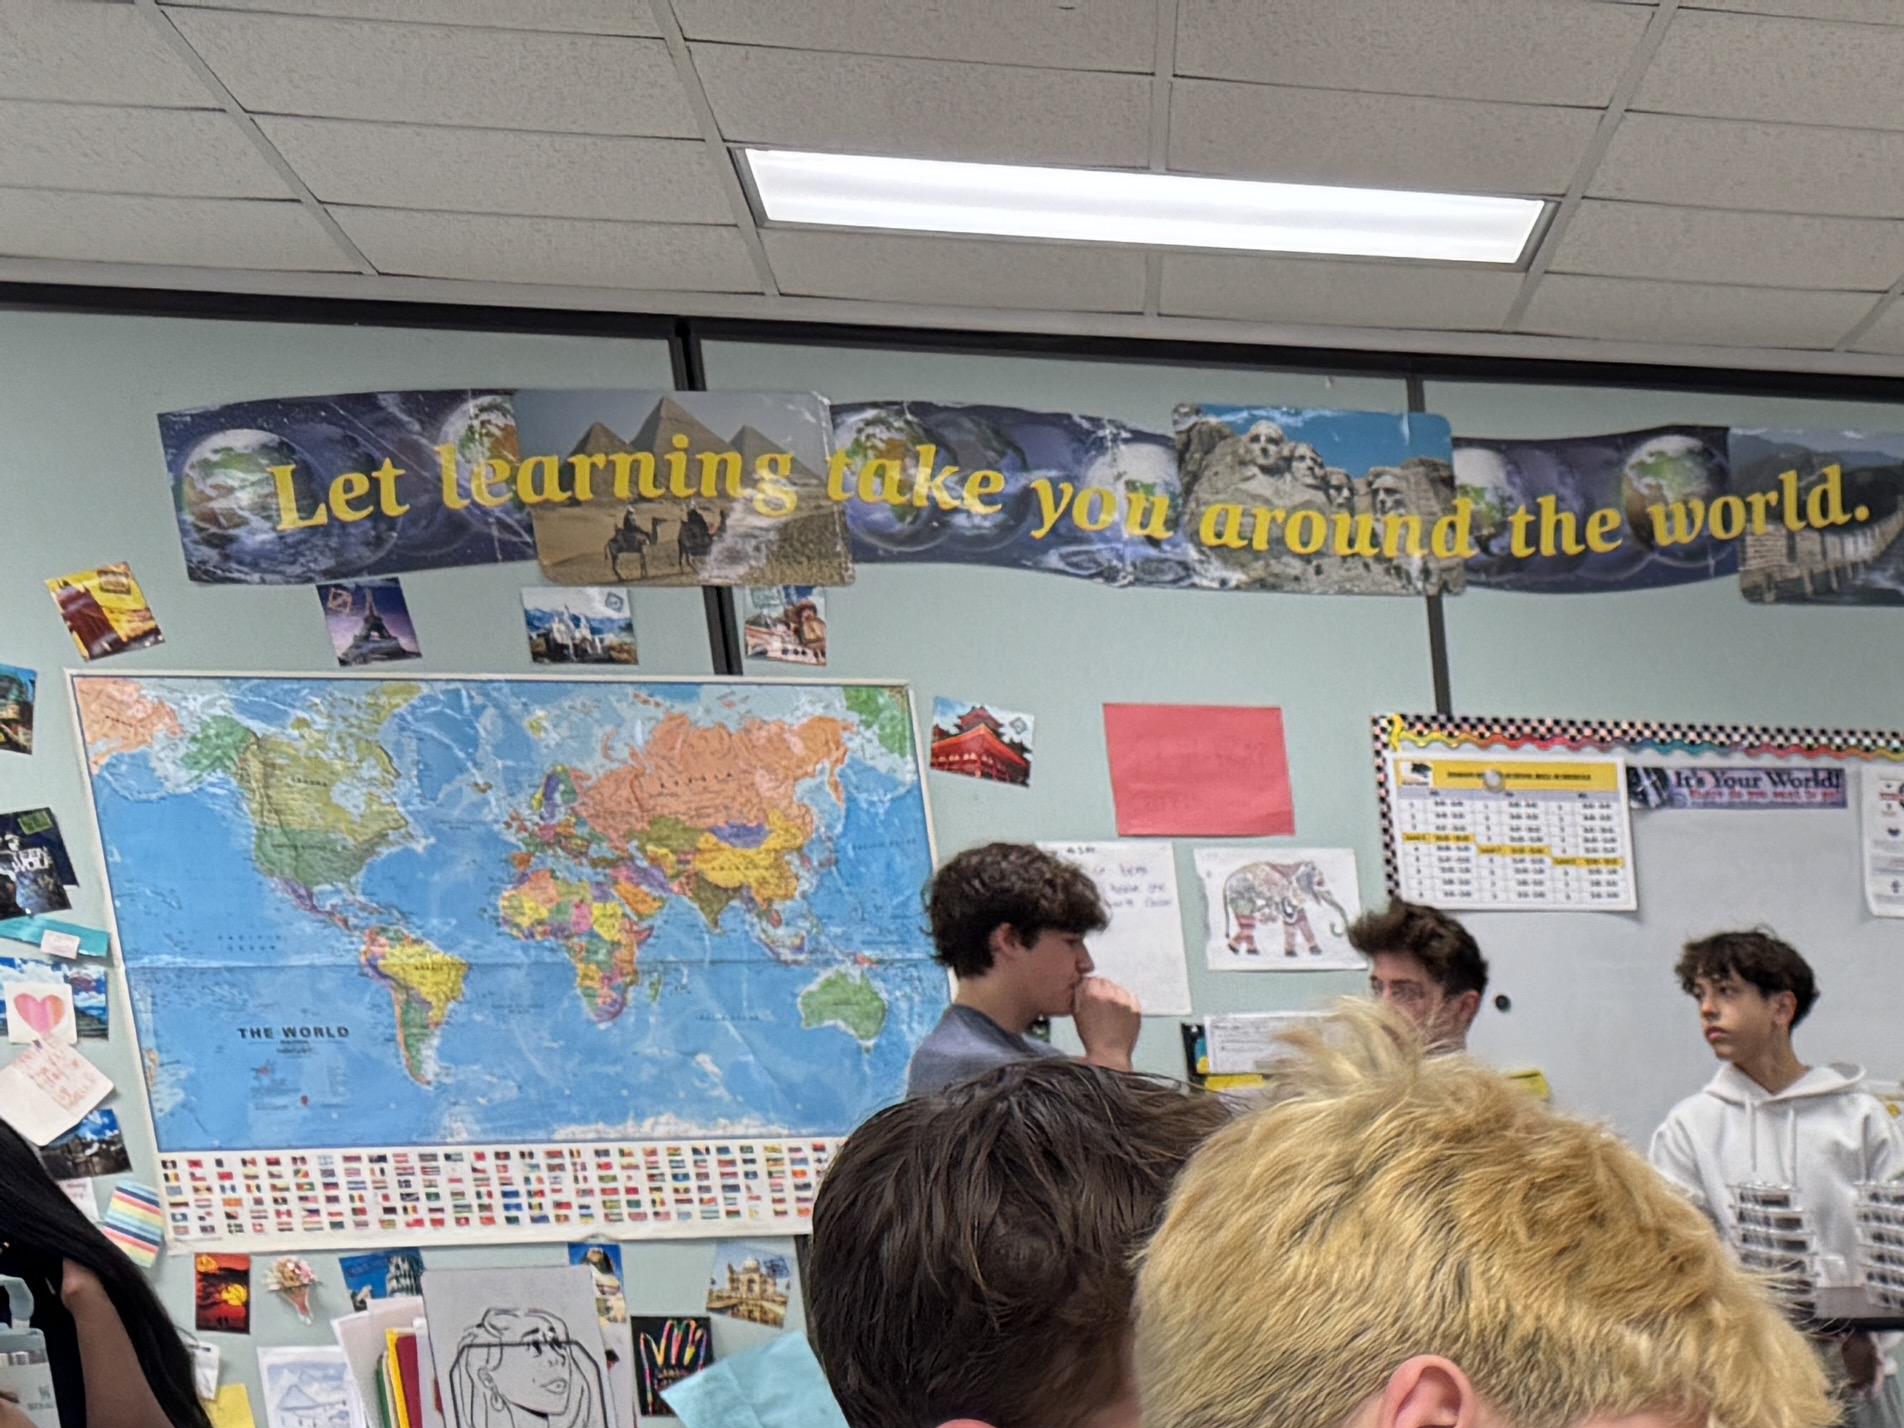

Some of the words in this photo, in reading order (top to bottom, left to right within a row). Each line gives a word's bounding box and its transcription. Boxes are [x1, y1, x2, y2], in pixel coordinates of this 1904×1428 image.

[265, 457, 411, 532] Let
[434, 433, 799, 518] learning
[825, 443, 1006, 515] take
[1029, 476, 1175, 541] you
[1199, 496, 1477, 559] around
[1508, 494, 1624, 559] the
[1647, 463, 1871, 547] world.
[1674, 769, 1705, 788] It's
[1712, 770, 1763, 788] Your
[1766, 769, 1841, 789] World!
[238, 1027, 275, 1039] THE
[282, 1026, 349, 1039] WORLD
